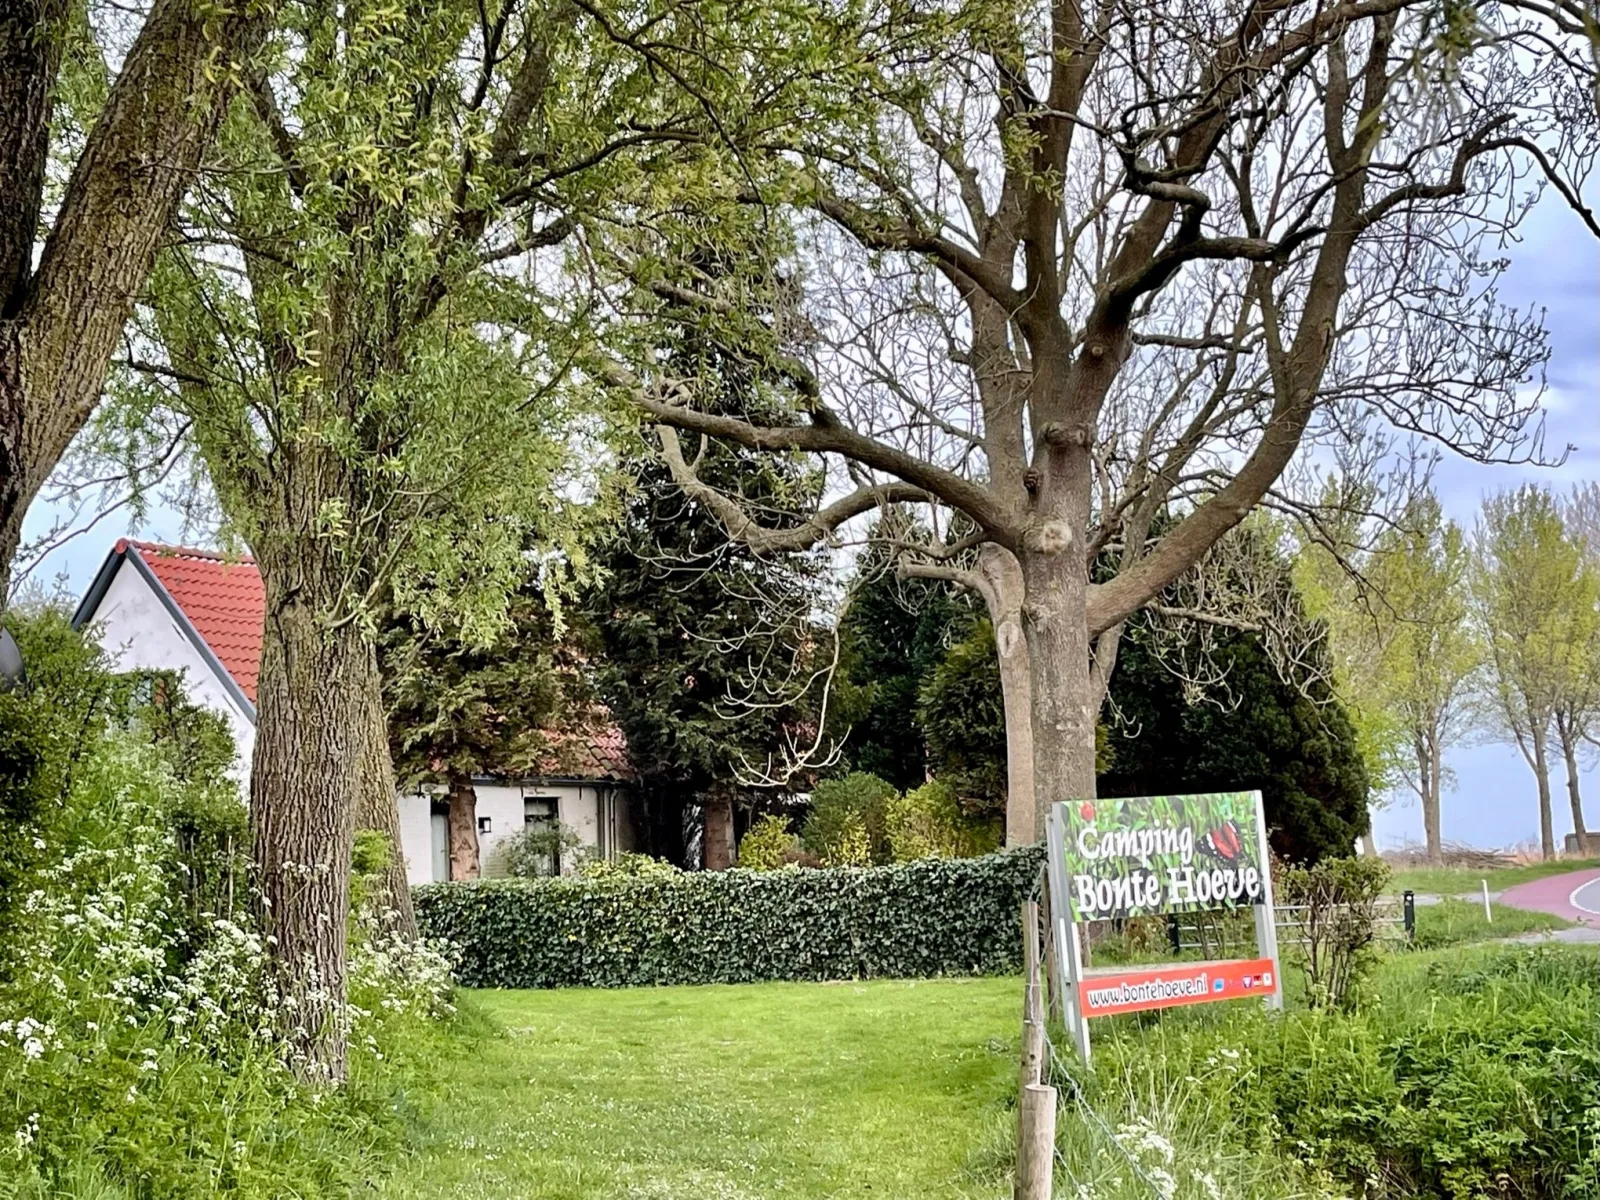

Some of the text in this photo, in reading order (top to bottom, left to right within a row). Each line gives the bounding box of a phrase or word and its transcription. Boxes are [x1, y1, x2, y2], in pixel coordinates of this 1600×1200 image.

[1077, 819, 1193, 866] Camping
[1074, 866, 1260, 912] Bonte Hoeve
[1088, 975, 1208, 1007] www.bontehoeve.nl
